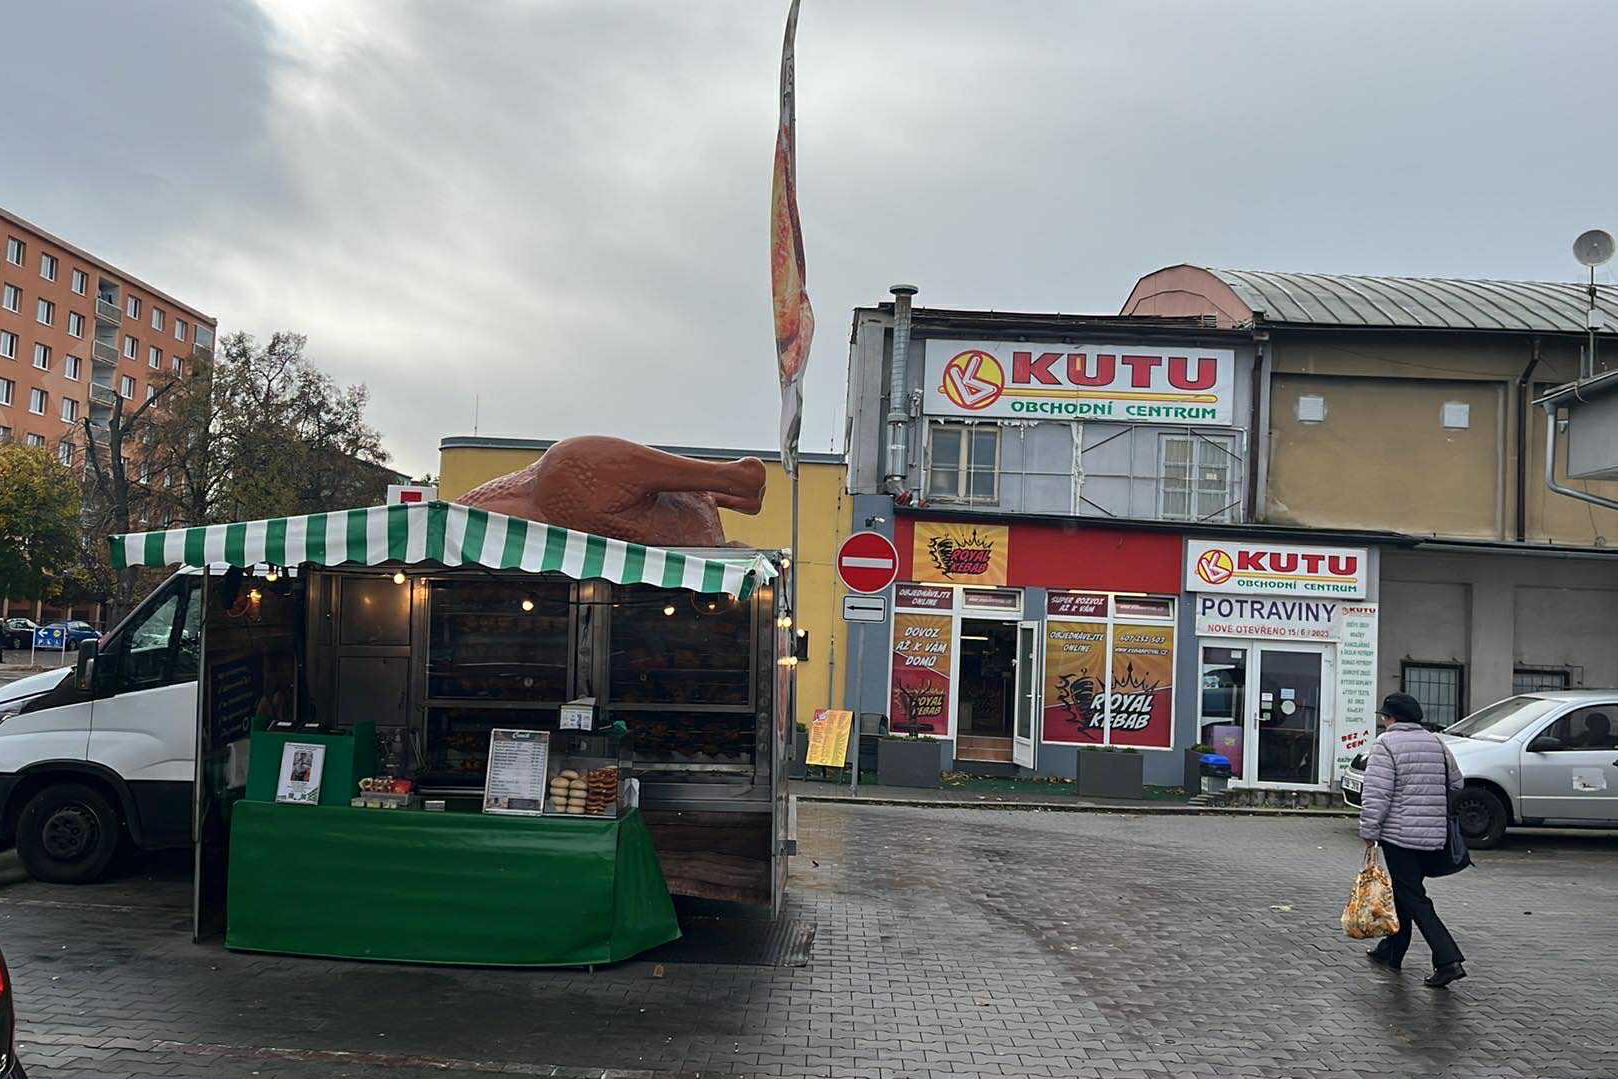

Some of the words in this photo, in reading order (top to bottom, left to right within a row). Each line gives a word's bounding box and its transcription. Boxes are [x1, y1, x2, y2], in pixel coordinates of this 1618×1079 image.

[1012, 352, 1217, 390] KUTU
[1011, 401, 1113, 415] OBCHODNÍ
[1126, 405, 1216, 419] CENTRUM
[951, 549, 990, 561] ROYAL
[950, 562, 986, 573] KEBAB
[1237, 551, 1358, 576] KUTU
[1237, 580, 1297, 590] OBCHODNÍ
[1304, 583, 1357, 592] CENTRUM
[1201, 598, 1336, 623] POTRAVINY
[905, 627, 940, 638] DOVOZ
[913, 642, 922, 651] K
[1090, 693, 1153, 712] ROYAL
